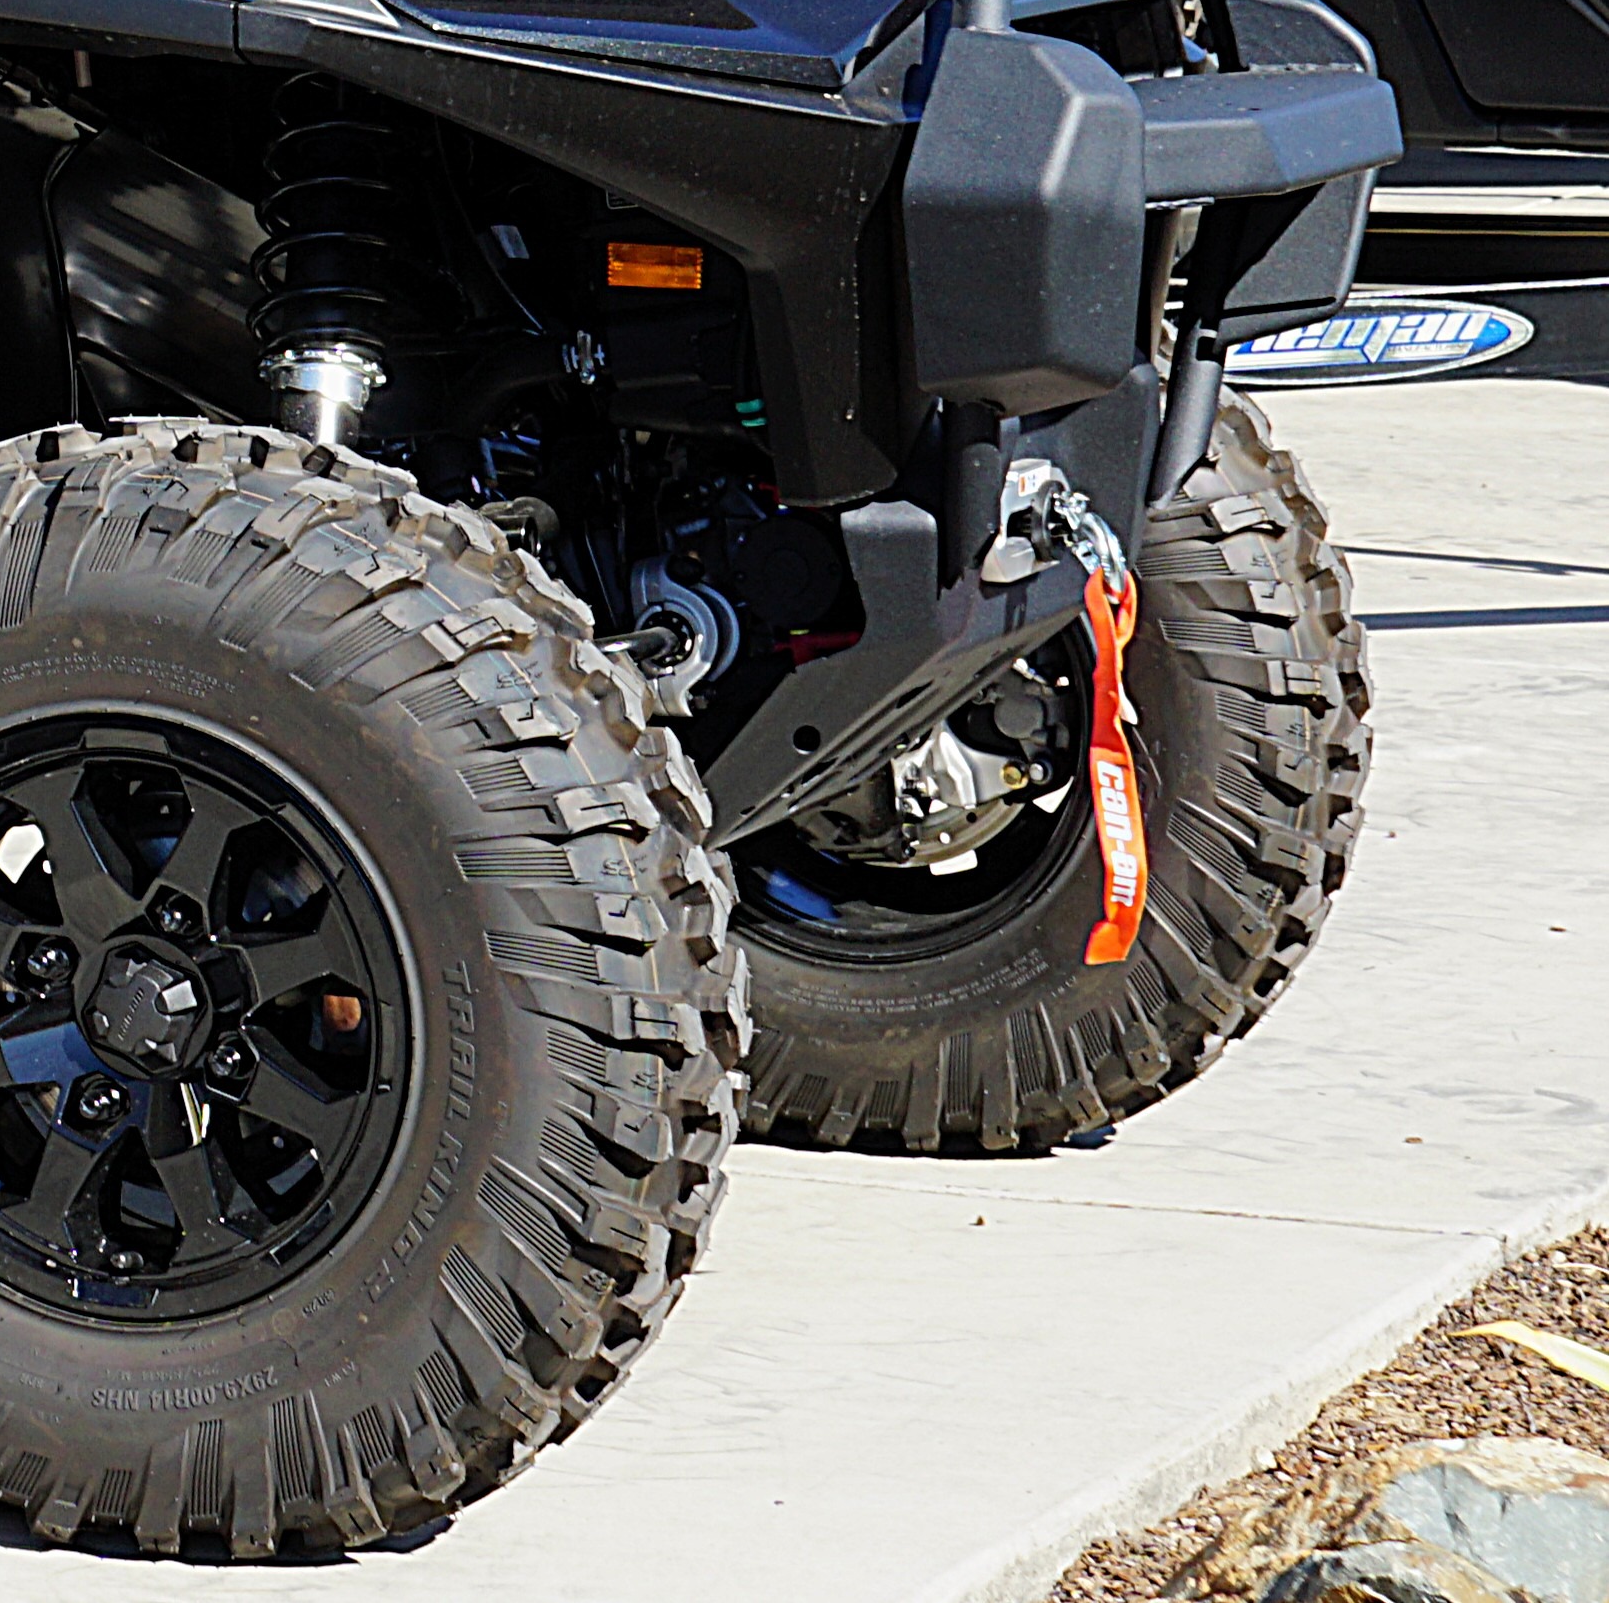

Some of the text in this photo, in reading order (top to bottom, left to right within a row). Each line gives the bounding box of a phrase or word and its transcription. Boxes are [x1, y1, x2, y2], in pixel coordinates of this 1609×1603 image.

[1096, 760, 1138, 907] can-am
[442, 959, 477, 1122] TRAIL
[390, 1129, 466, 1267] KING
[90, 1364, 279, 1413] 29X9.00R14 NHS
